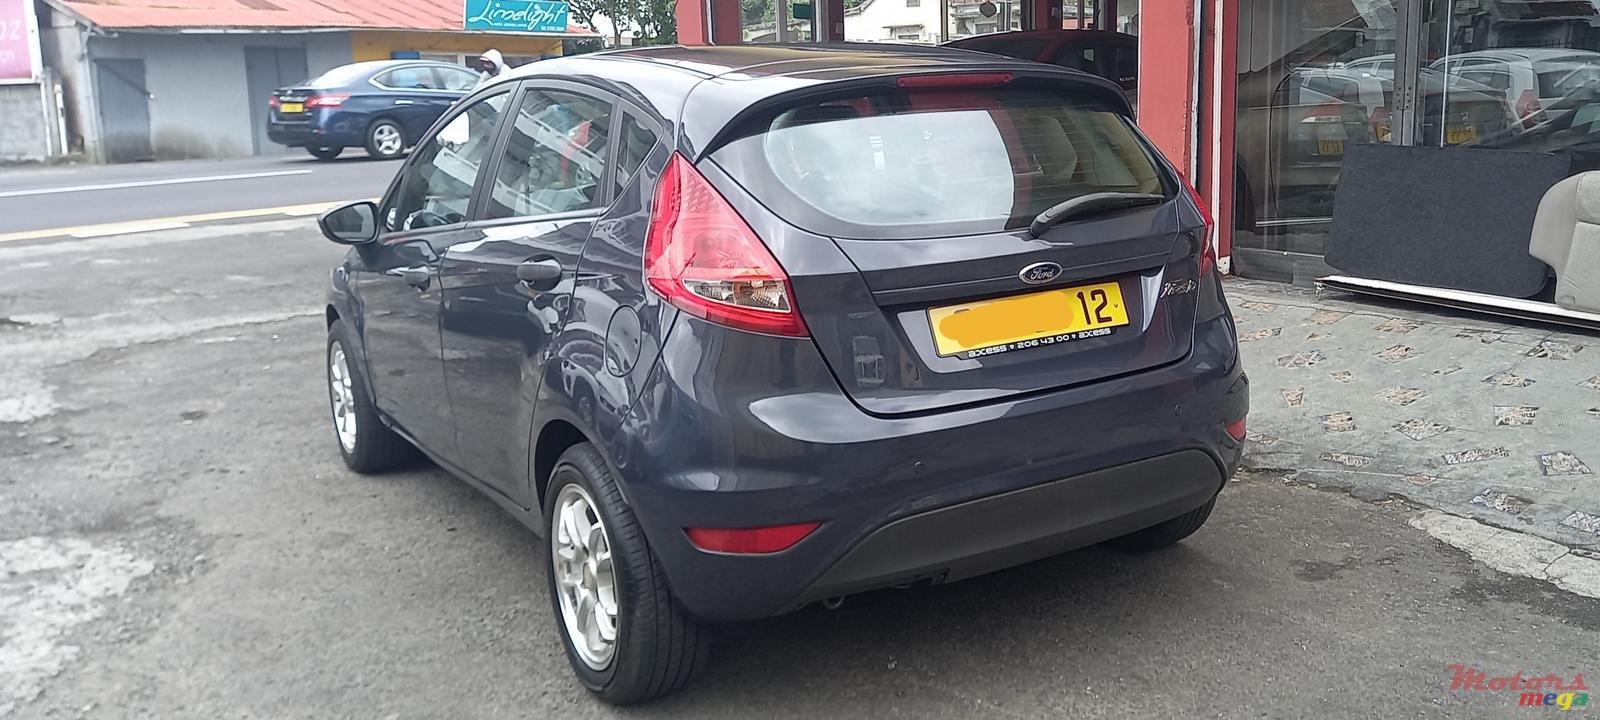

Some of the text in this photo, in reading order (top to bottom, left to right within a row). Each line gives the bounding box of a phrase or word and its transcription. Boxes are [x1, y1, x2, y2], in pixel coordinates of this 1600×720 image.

[467, 0, 566, 31] Limelight
[1030, 268, 1055, 280] Ford
[1076, 289, 1113, 325] 12
[1017, 338, 1040, 350] 206
[1039, 335, 1055, 346] 43
